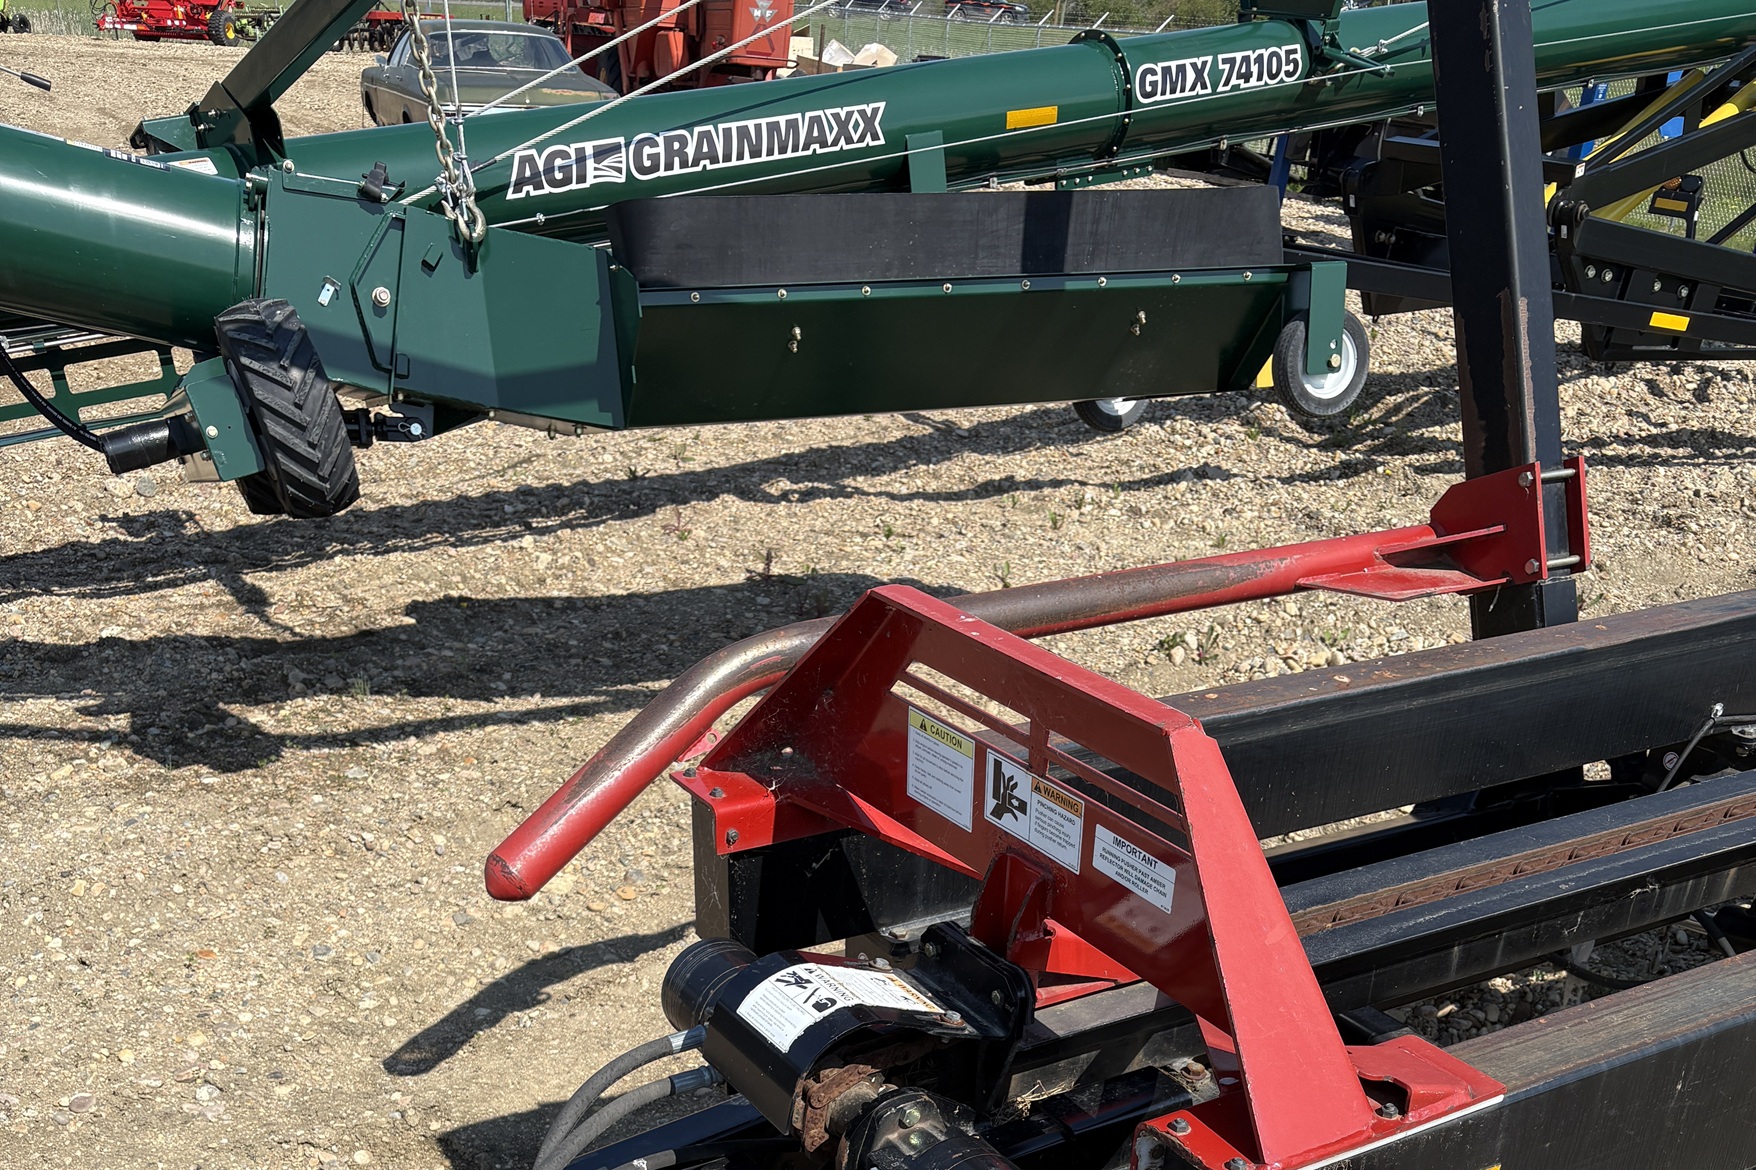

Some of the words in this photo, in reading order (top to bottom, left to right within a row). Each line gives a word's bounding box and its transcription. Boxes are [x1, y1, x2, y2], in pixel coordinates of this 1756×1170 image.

[1137, 57, 1211, 102] GMX
[1218, 45, 1302, 91] 74105
[509, 144, 588, 197] AGI
[630, 103, 884, 179] GRAINMAXX
[930, 724, 962, 750] CAUTION
[1037, 799, 1057, 815] PINCHING
[1057, 811, 1076, 826] HAZARD
[1043, 785, 1079, 813] WARNING
[1102, 847, 1121, 862] RUNNING
[1121, 858, 1138, 873] PUSHER
[1138, 868, 1150, 879] PAST
[1150, 876, 1166, 890] AMBER
[1112, 836, 1158, 869] IMPORTANT
[1099, 852, 1123, 872] REFLECTOR
[1123, 866, 1134, 878] WILL
[1134, 874, 1152, 889] DAMAGE
[1153, 886, 1167, 898] CHAIN
[815, 973, 854, 1001] WARNING
